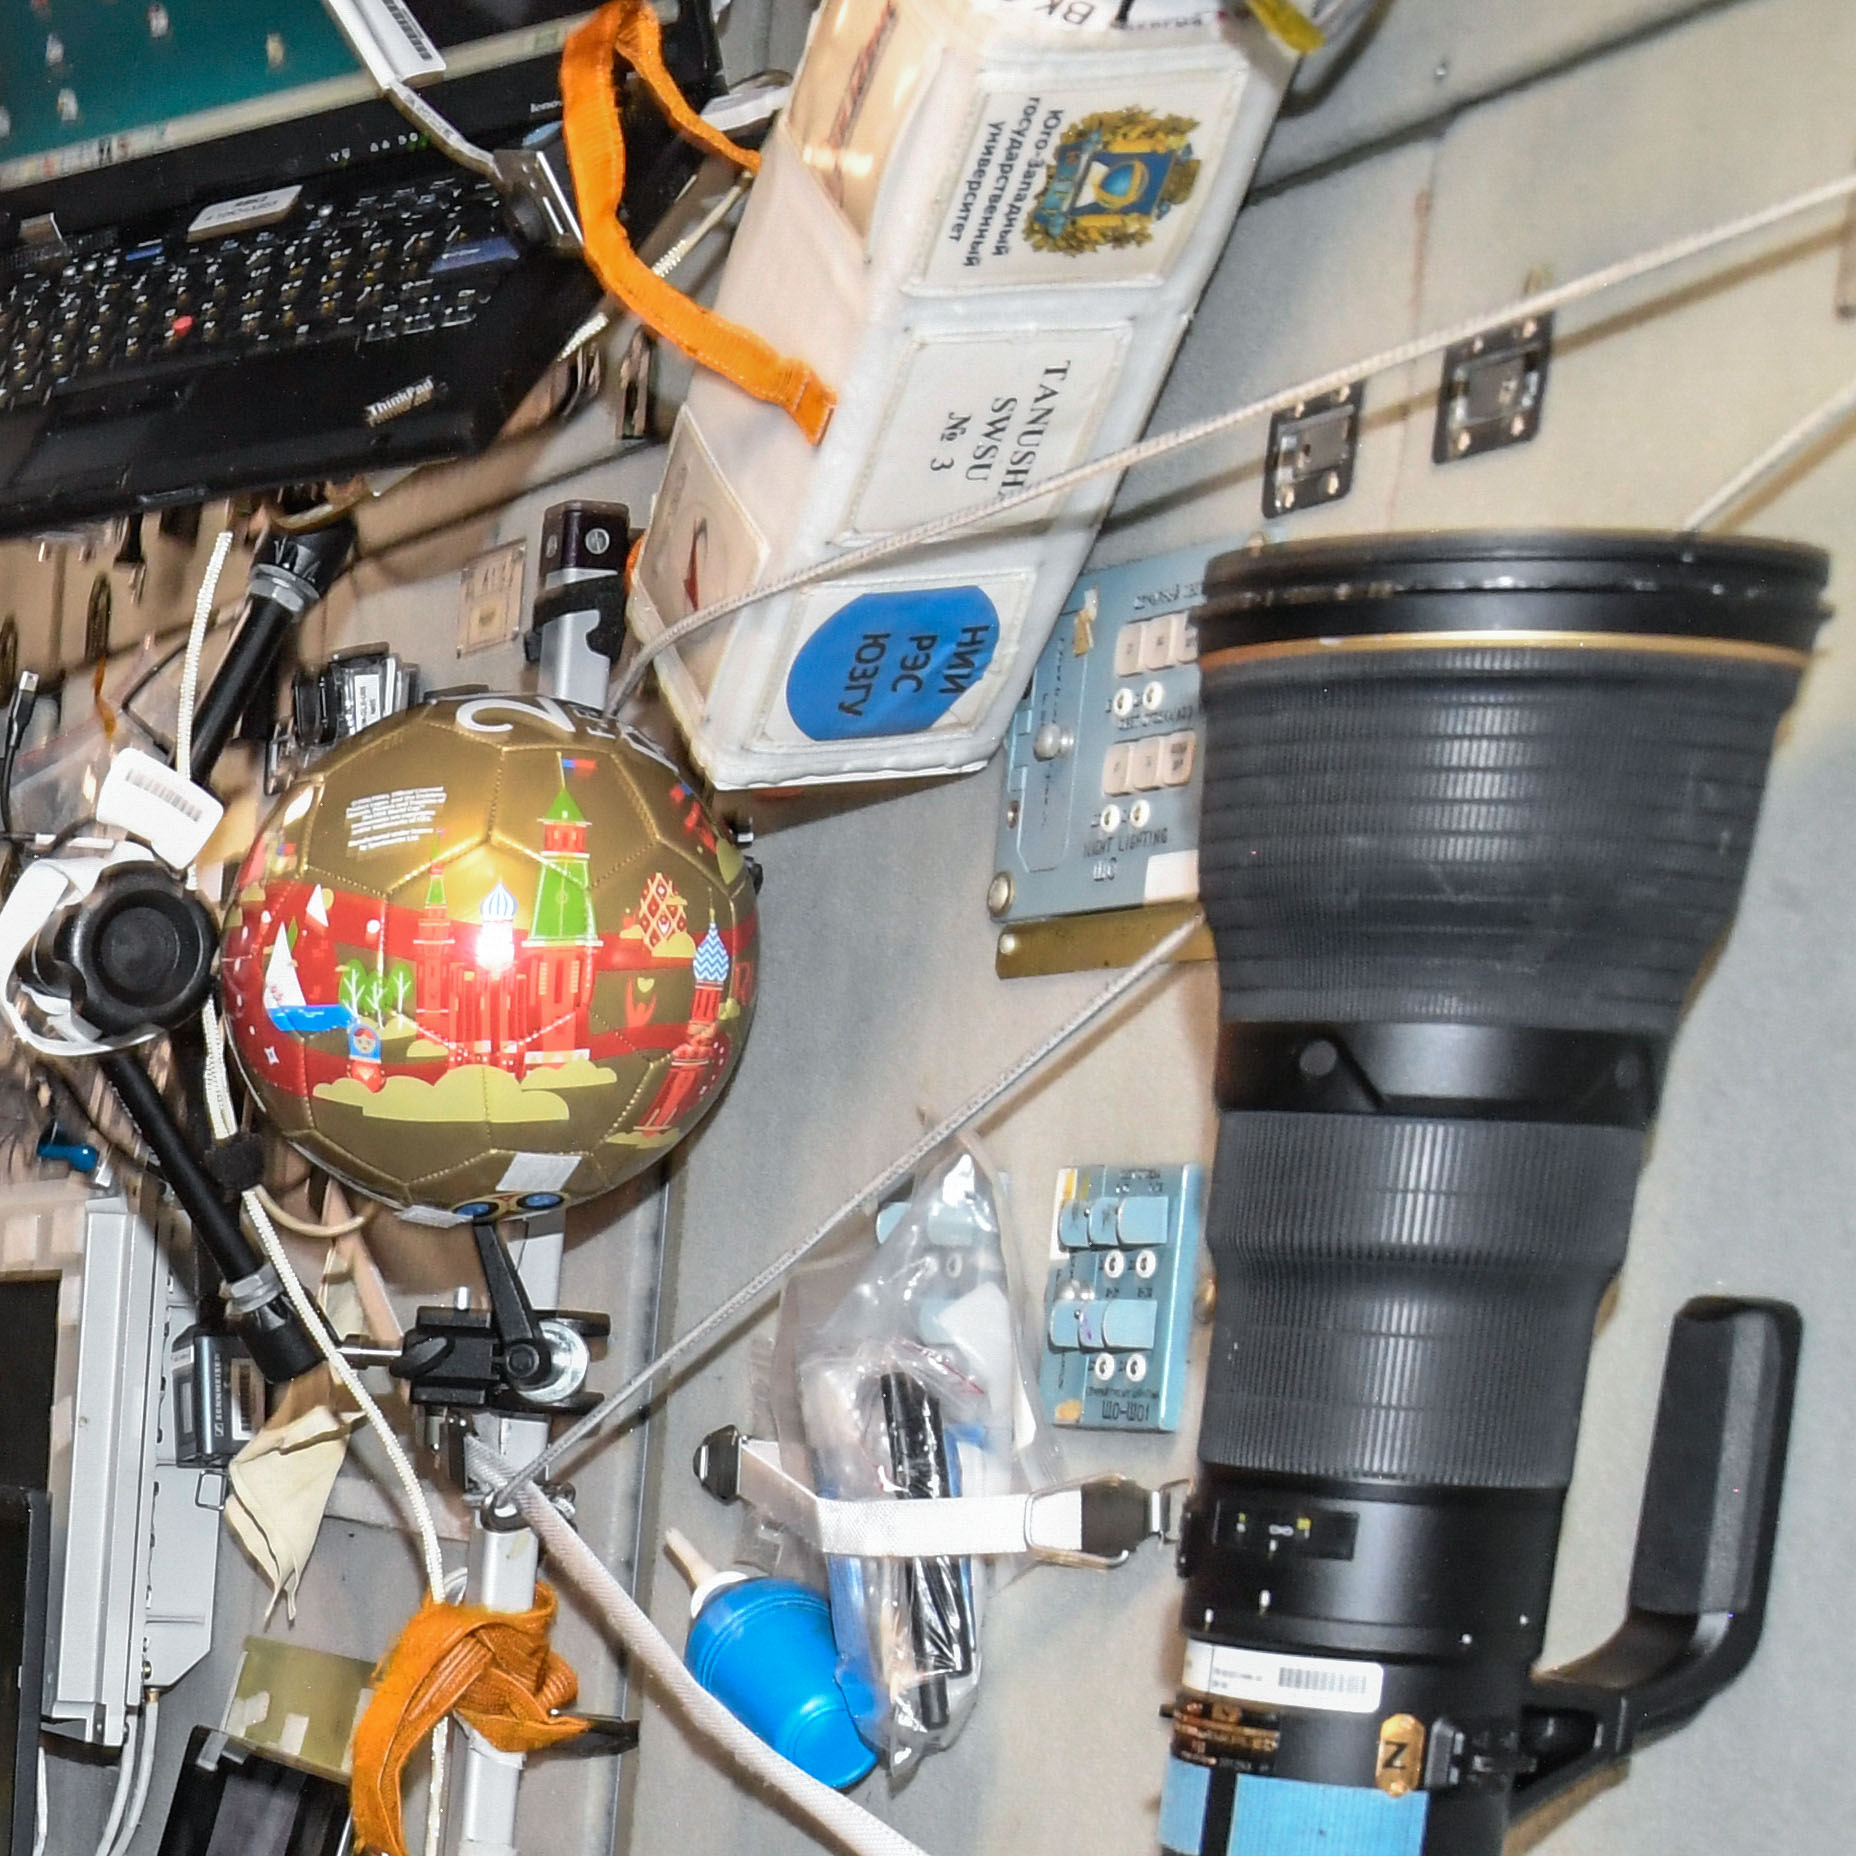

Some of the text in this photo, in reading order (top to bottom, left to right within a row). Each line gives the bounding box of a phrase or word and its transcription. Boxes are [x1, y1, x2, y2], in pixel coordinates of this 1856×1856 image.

[949, 121, 1006, 242] университет
[963, 97, 1041, 267] государственный
[993, 109, 1065, 257] Юго-Западный
[929, 456, 956, 472] 3
[964, 396, 1019, 482] SWSU
[996, 359, 1072, 502] TANUSH
[838, 632, 892, 717] ЮЗГУ
[890, 634, 939, 694] РЭС
[938, 625, 990, 694] НИИ
